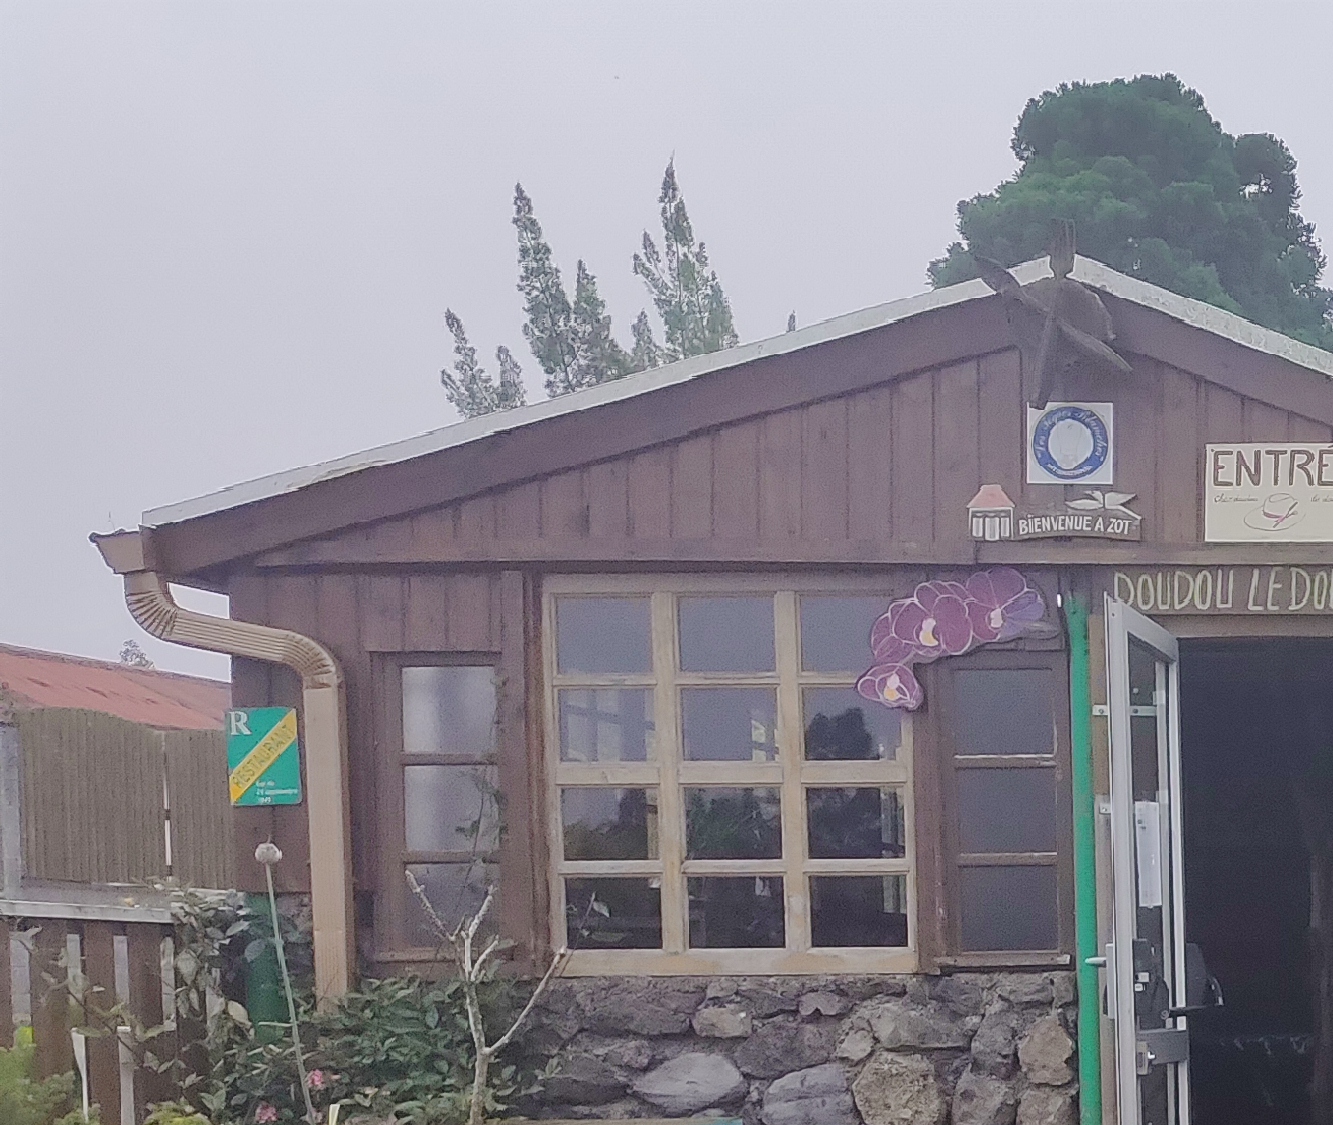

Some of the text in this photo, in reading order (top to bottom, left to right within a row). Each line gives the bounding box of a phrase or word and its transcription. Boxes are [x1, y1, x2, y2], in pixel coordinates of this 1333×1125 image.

[1094, 520, 1105, 533] A
[1107, 518, 1132, 535] ZOT
[1113, 569, 1234, 610] DOUDOU
[228, 710, 252, 736] R
[232, 723, 296, 789] RESTAURANT
